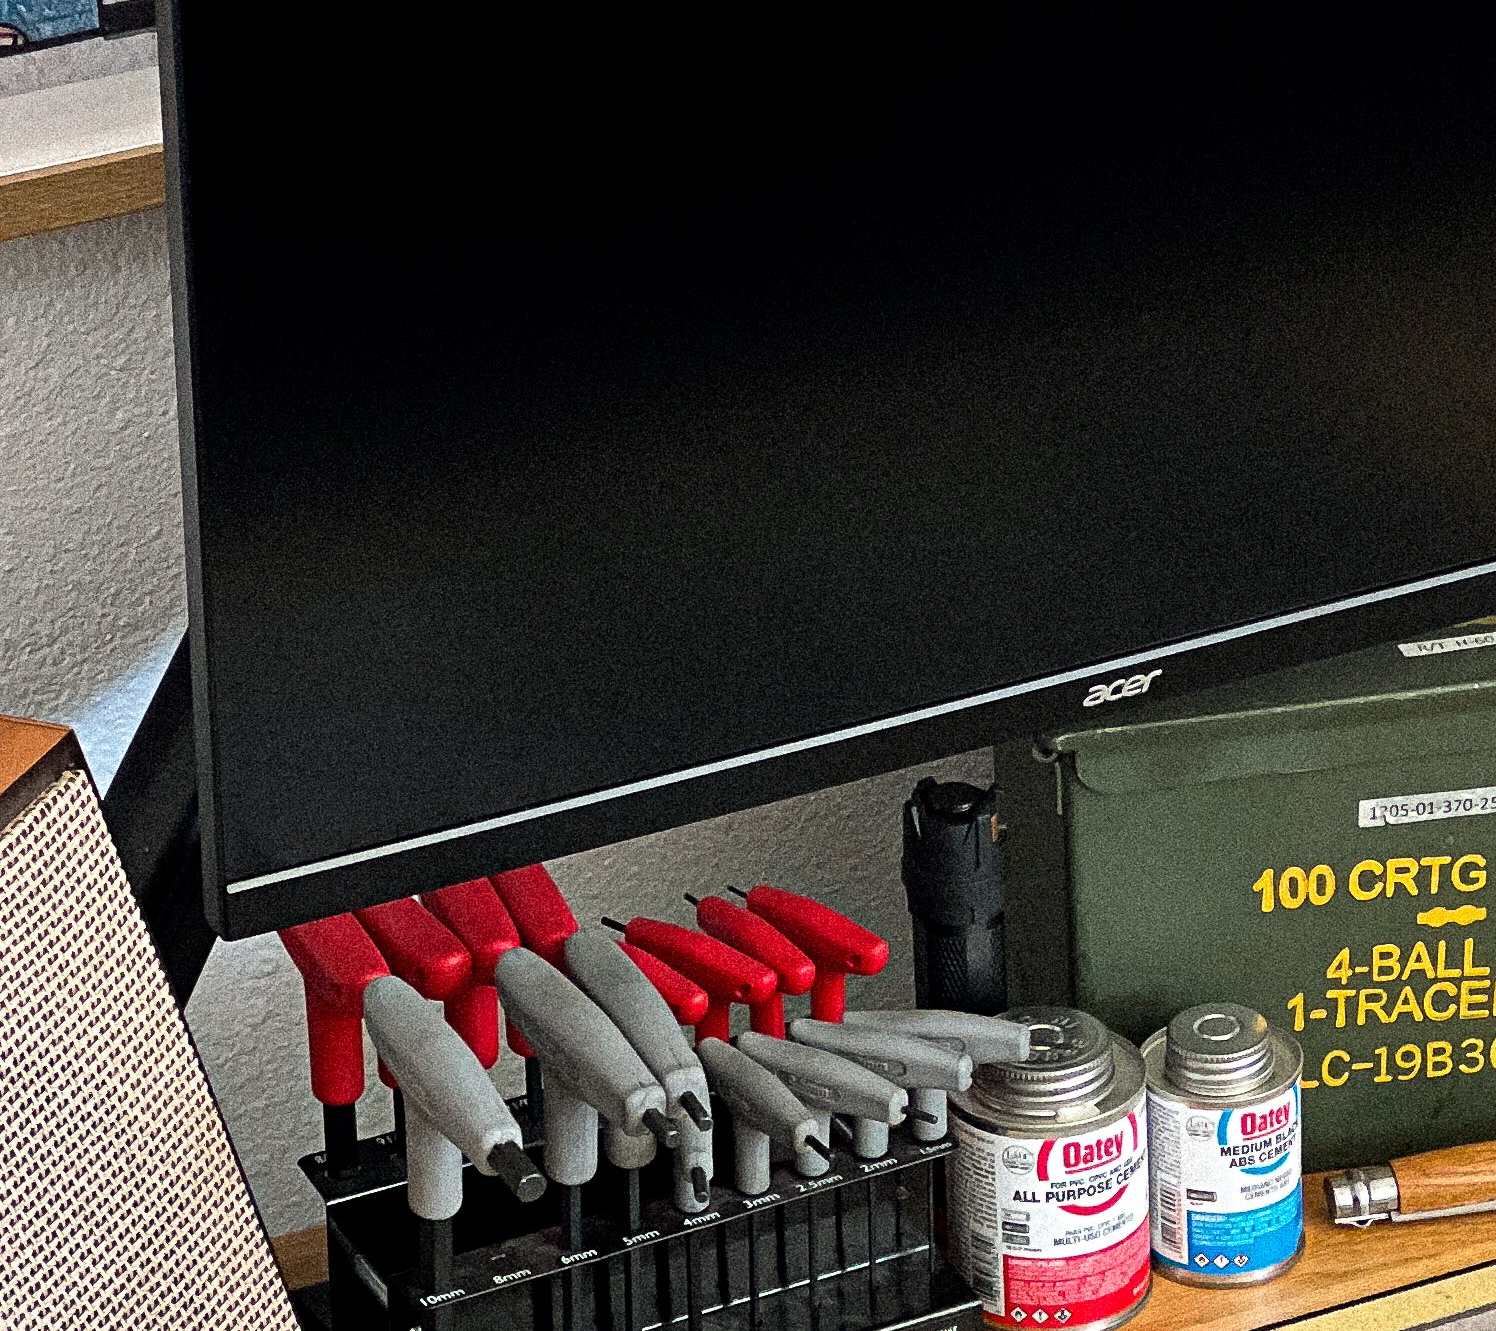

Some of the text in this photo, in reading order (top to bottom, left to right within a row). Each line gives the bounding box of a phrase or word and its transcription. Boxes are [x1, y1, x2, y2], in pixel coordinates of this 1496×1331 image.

[1082, 668, 1163, 707] acer
[1252, 864, 1336, 913] 100
[1348, 853, 1488, 902] CRTG
[1326, 937, 1491, 985] 4-BALL
[1240, 1101, 1291, 1136] Oatey
[1062, 1130, 1124, 1169] Oatey
[1220, 1138, 1273, 1157] MEDIUM
[859, 1157, 898, 1173] 2mm
[1229, 1155, 1256, 1169] ABS
[795, 1174, 844, 1193] 2.5mm
[1012, 1189, 1041, 1204] ALL
[1045, 1177, 1113, 1203] PURPOSE
[1050, 1181, 1067, 1190] FOR
[742, 1193, 781, 1209] 3mm
[682, 1211, 721, 1227] 4mm
[622, 1230, 660, 1246] 5mm
[560, 1248, 598, 1265] 6mm
[492, 1269, 532, 1285] 8mm
[419, 1288, 466, 1307] 10mm
